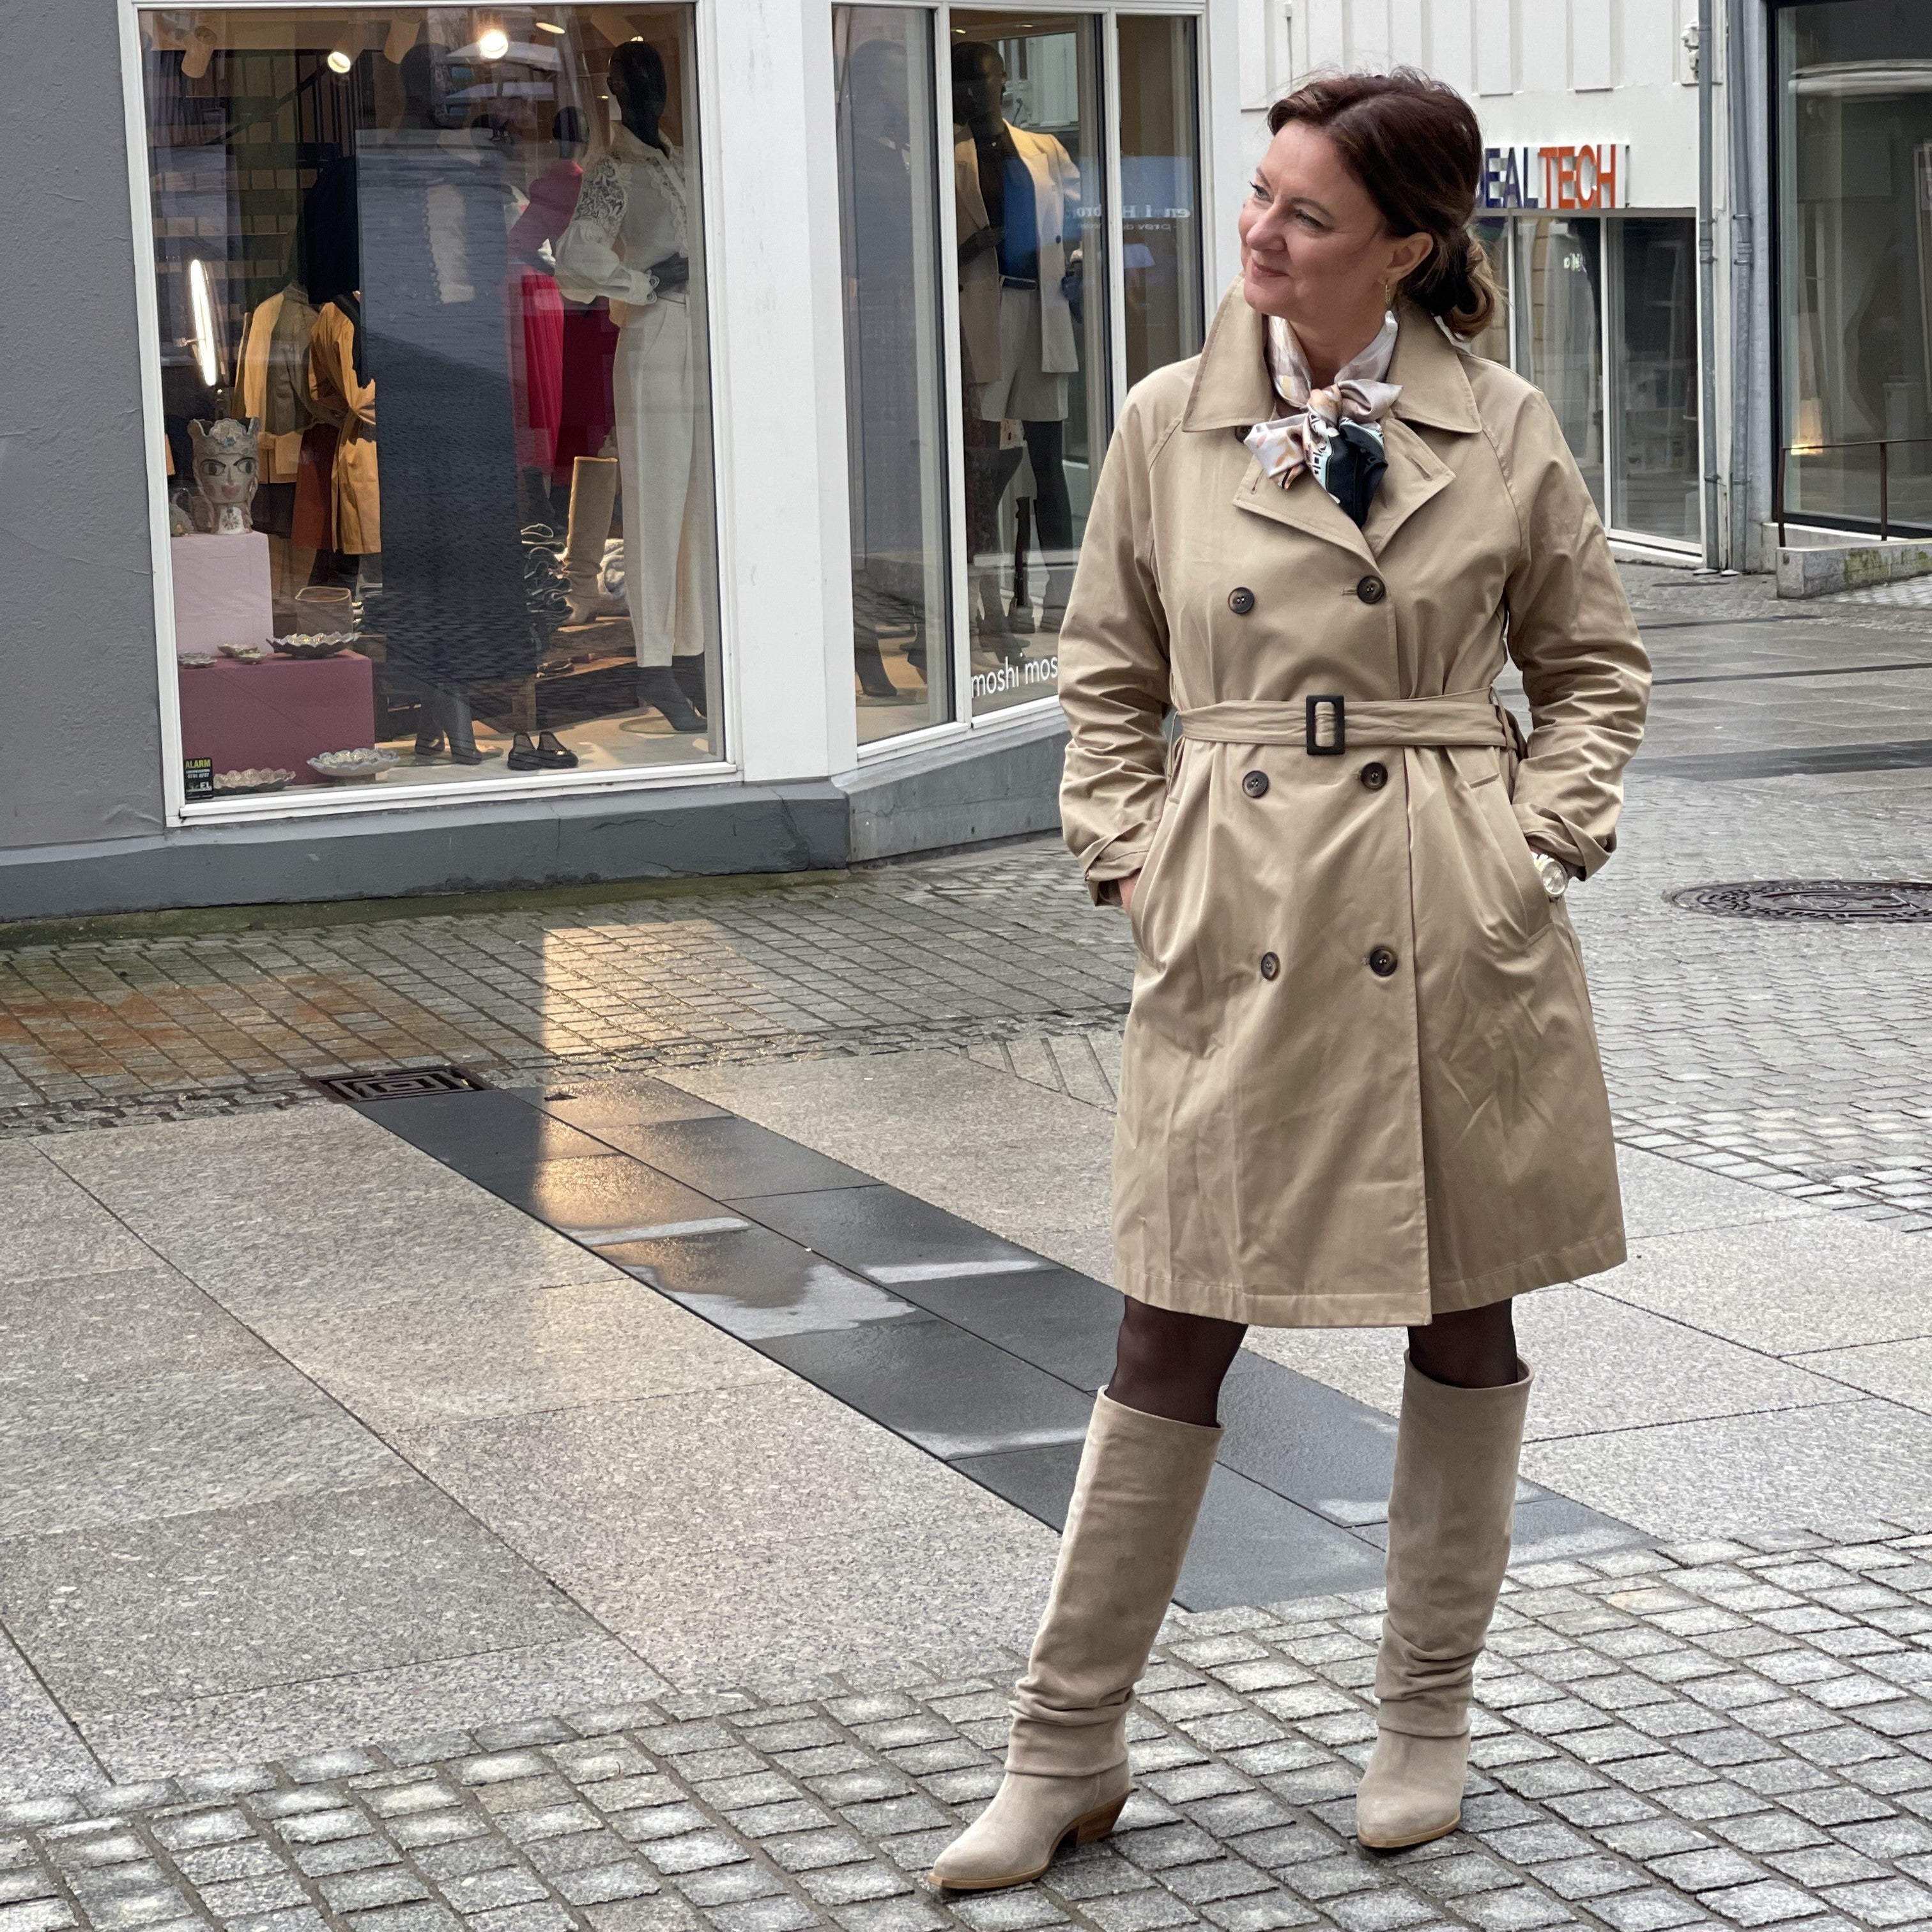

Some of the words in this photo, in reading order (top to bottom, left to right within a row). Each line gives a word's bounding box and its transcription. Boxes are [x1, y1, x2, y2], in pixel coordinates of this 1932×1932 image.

[1475, 144, 1616, 210] EALTECH
[971, 652, 1022, 698] moshi
[185, 759, 211, 768] ALARM
